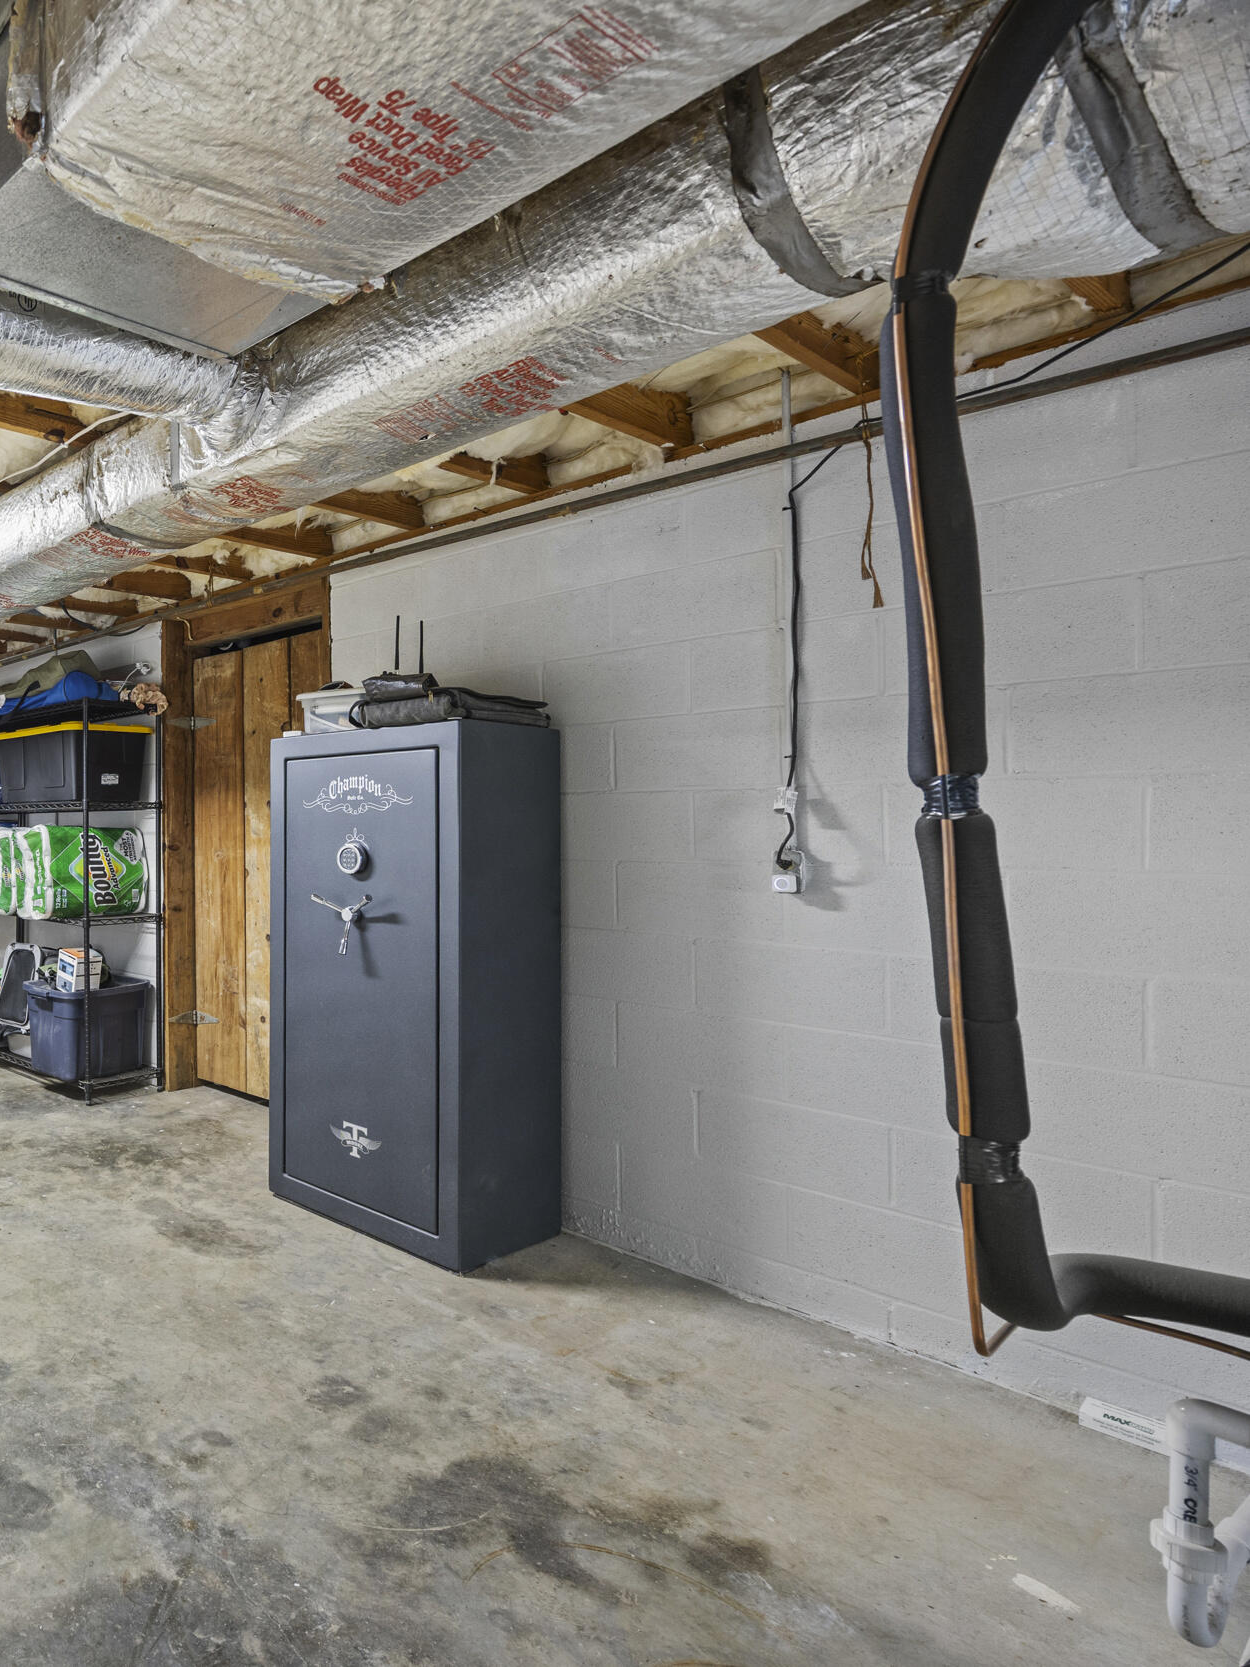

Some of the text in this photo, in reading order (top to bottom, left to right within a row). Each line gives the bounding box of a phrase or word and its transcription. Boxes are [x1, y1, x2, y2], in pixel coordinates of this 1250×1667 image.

[376, 89, 417, 118] 75
[411, 107, 460, 144] Type
[313, 76, 473, 176] Faced Duct Wrap
[345, 156, 427, 201] Fiberglas
[348, 131, 449, 189] All Service
[329, 774, 382, 800] Champion
[80, 832, 118, 906] Bounty
[101, 846, 121, 890] Advanced
